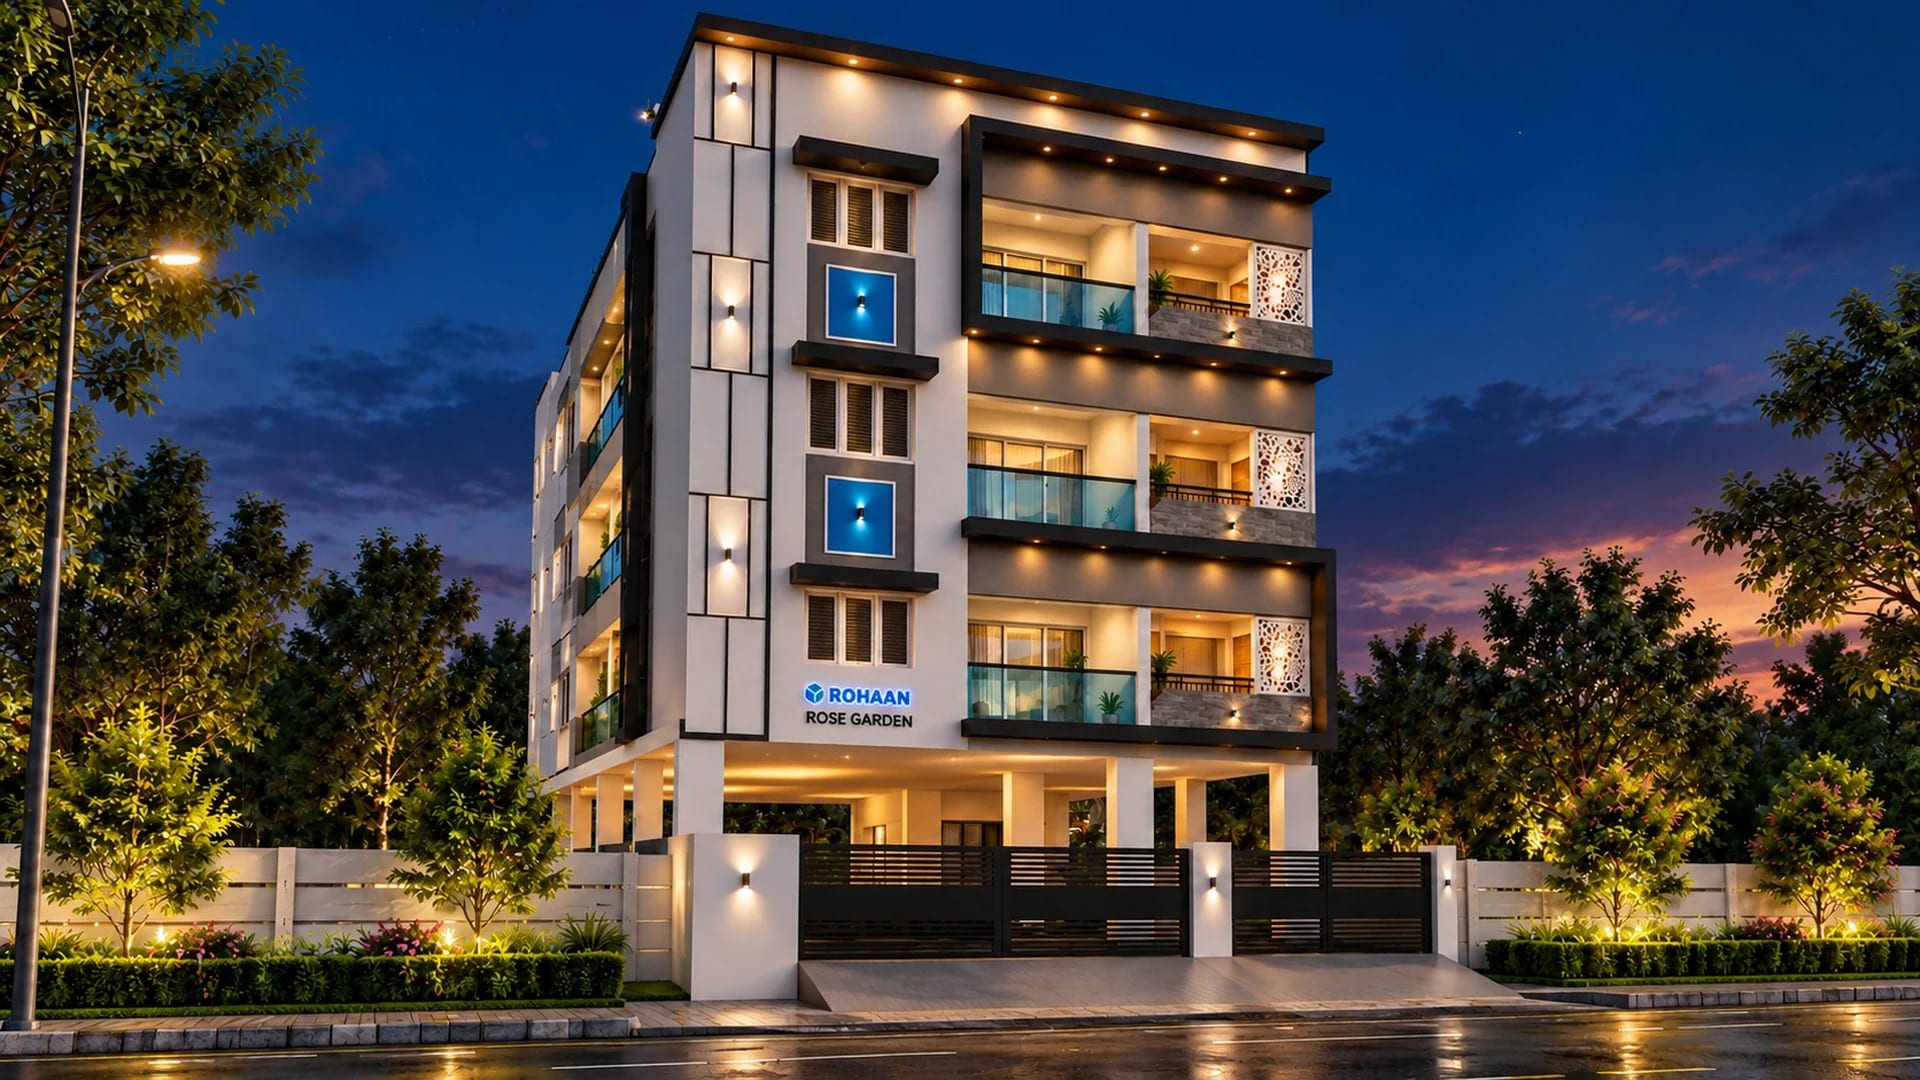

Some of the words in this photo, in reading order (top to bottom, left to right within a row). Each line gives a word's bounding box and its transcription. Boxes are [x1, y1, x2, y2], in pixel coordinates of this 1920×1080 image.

[829, 687, 910, 705] ROHAAN
[806, 711, 846, 725] ROSE
[850, 713, 913, 728] GARDEN
